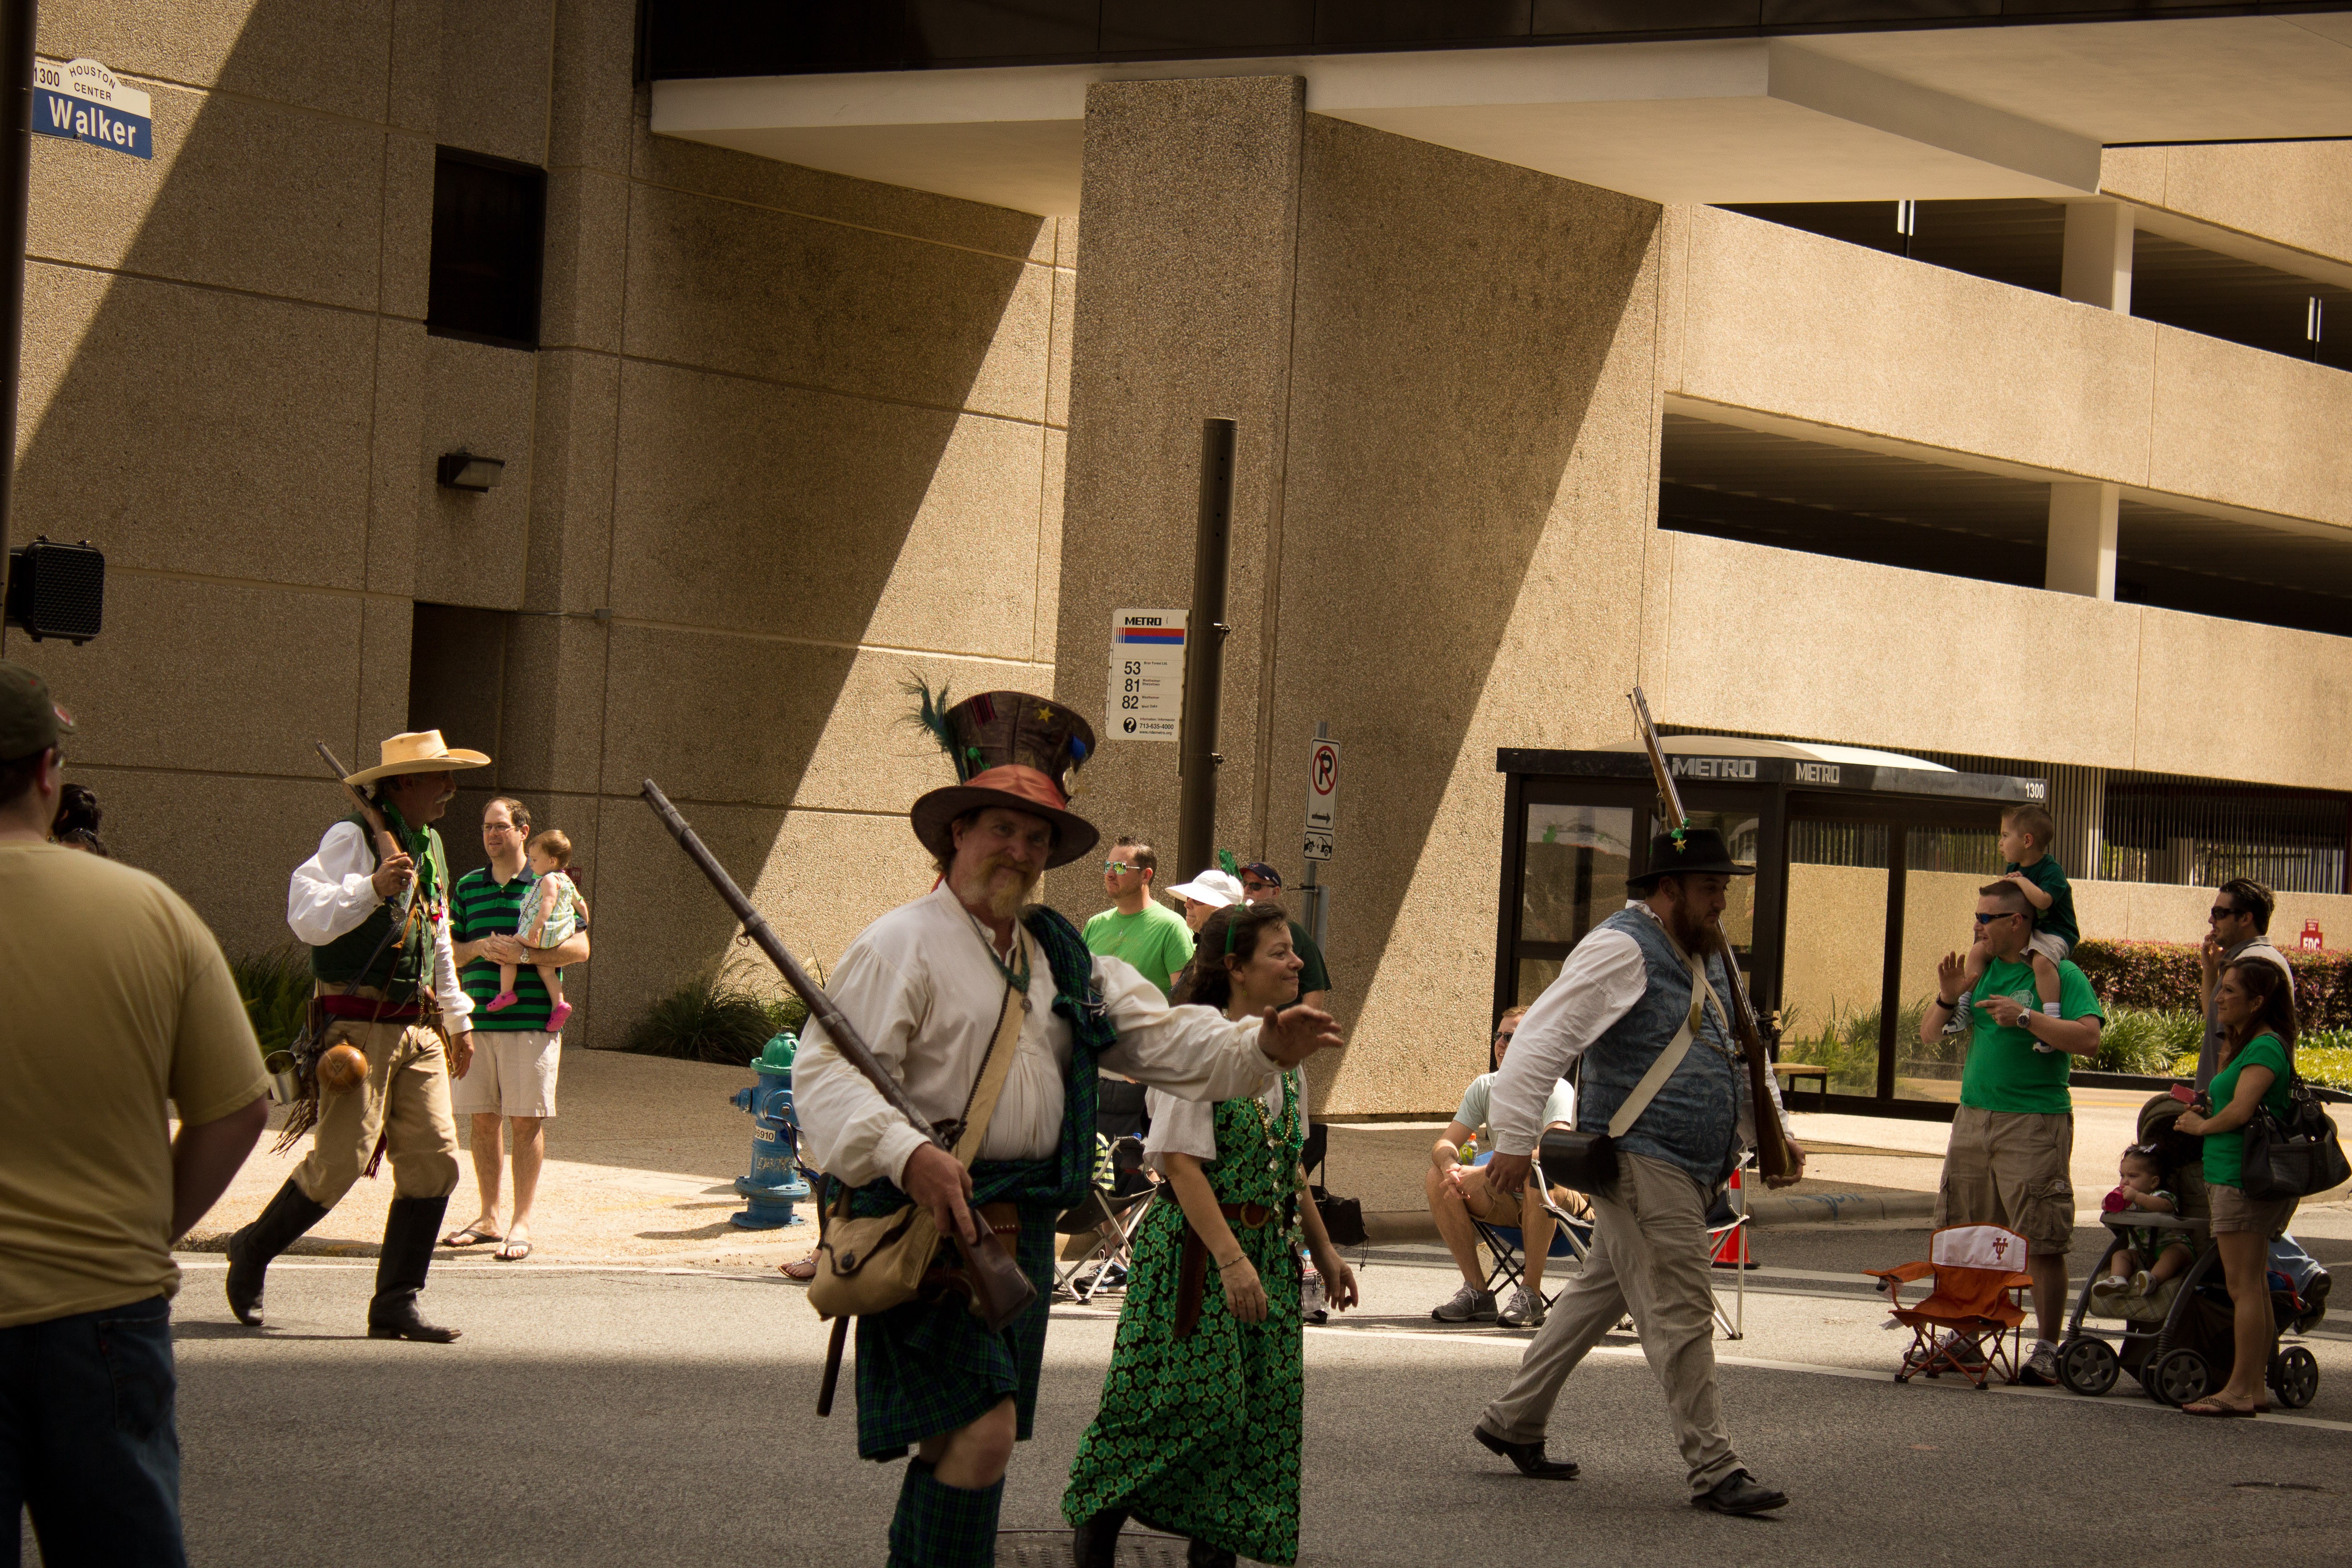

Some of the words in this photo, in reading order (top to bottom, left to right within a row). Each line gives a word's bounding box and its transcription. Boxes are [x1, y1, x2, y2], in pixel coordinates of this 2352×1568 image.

[34, 67, 60, 87] 1300
[69, 66, 115, 89] HOUSTON
[74, 83, 112, 101] CENTER
[49, 96, 136, 147] Walker
[1125, 617, 1161, 626] METRO
[1124, 662, 1141, 675] 53
[1125, 678, 1140, 692] 81
[1122, 696, 1138, 709] 82
[1672, 758, 1756, 778] METRO
[1796, 763, 1839, 784] METRO
[2025, 783, 2044, 799] 1300
